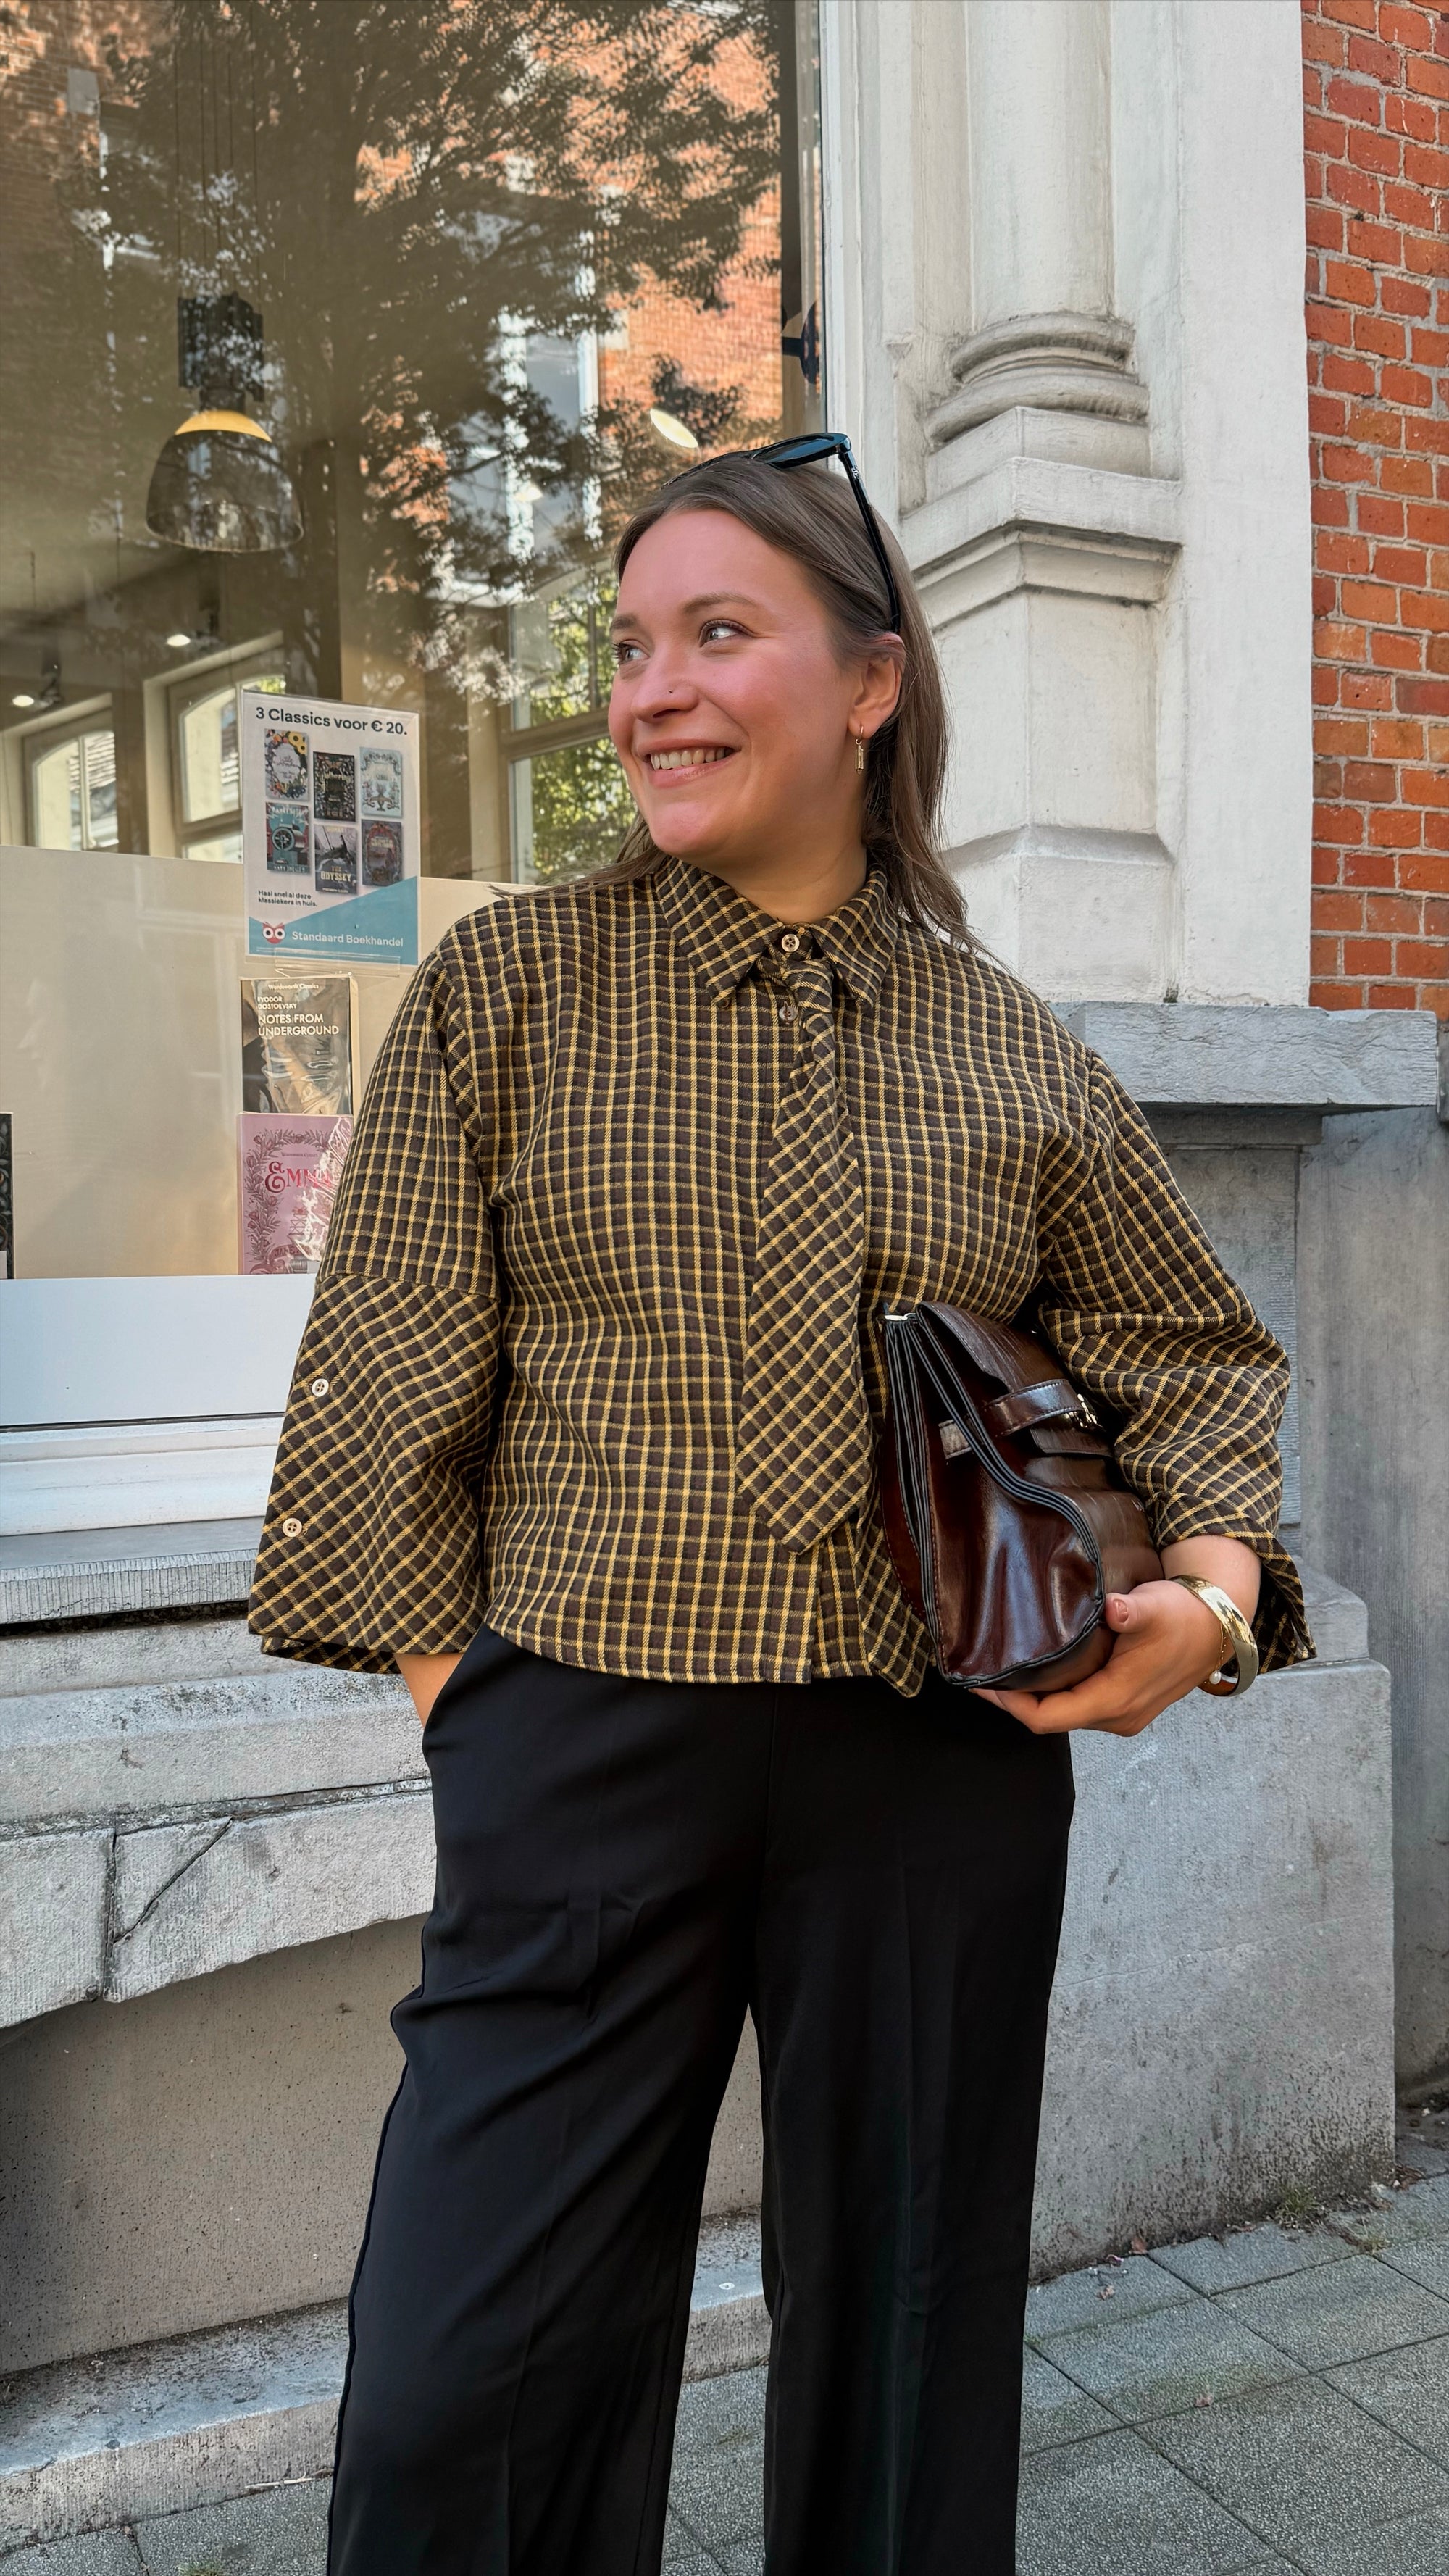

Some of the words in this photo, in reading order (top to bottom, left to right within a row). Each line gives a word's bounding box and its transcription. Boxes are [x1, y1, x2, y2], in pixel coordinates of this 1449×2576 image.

[256, 707, 265, 719] 3
[268, 708, 330, 727] Classics
[333, 718, 368, 730] voor
[371, 720, 383, 732] €
[386, 722, 408, 735] 20.
[320, 870, 352, 882] ODYSSEY
[258, 896, 294, 905] klassiekers
[292, 931, 344, 943] Standaard
[346, 935, 404, 947] Boekhandel
[258, 1014, 291, 1024] NOTES
[294, 1013, 324, 1023] FROM
[258, 1025, 339, 1036] UNDERGROUND
